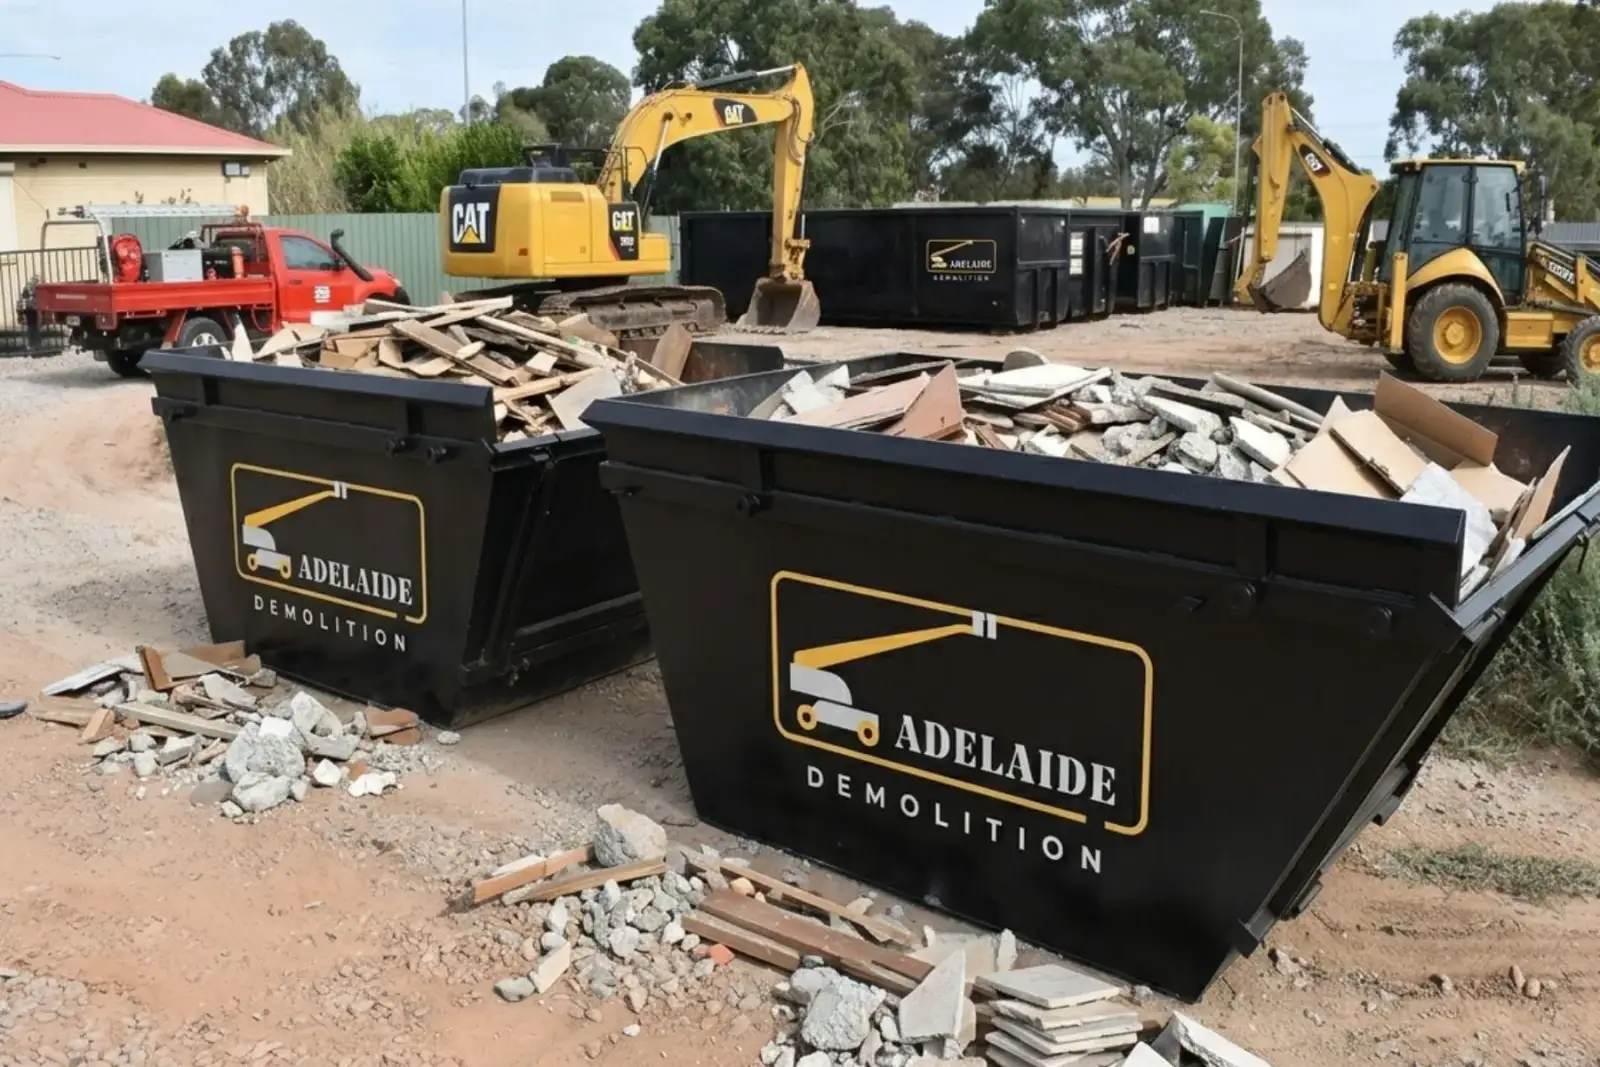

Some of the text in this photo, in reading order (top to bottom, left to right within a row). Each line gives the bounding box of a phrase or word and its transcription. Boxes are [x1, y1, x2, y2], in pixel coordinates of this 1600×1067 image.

[724, 104, 744, 125] CAT
[452, 202, 490, 244] CAT
[298, 554, 413, 606] ADELAIDE
[254, 594, 406, 652] DEMOLITION
[895, 715, 1116, 806] ADELAIDE
[807, 765, 1101, 873] DEMOLITION
